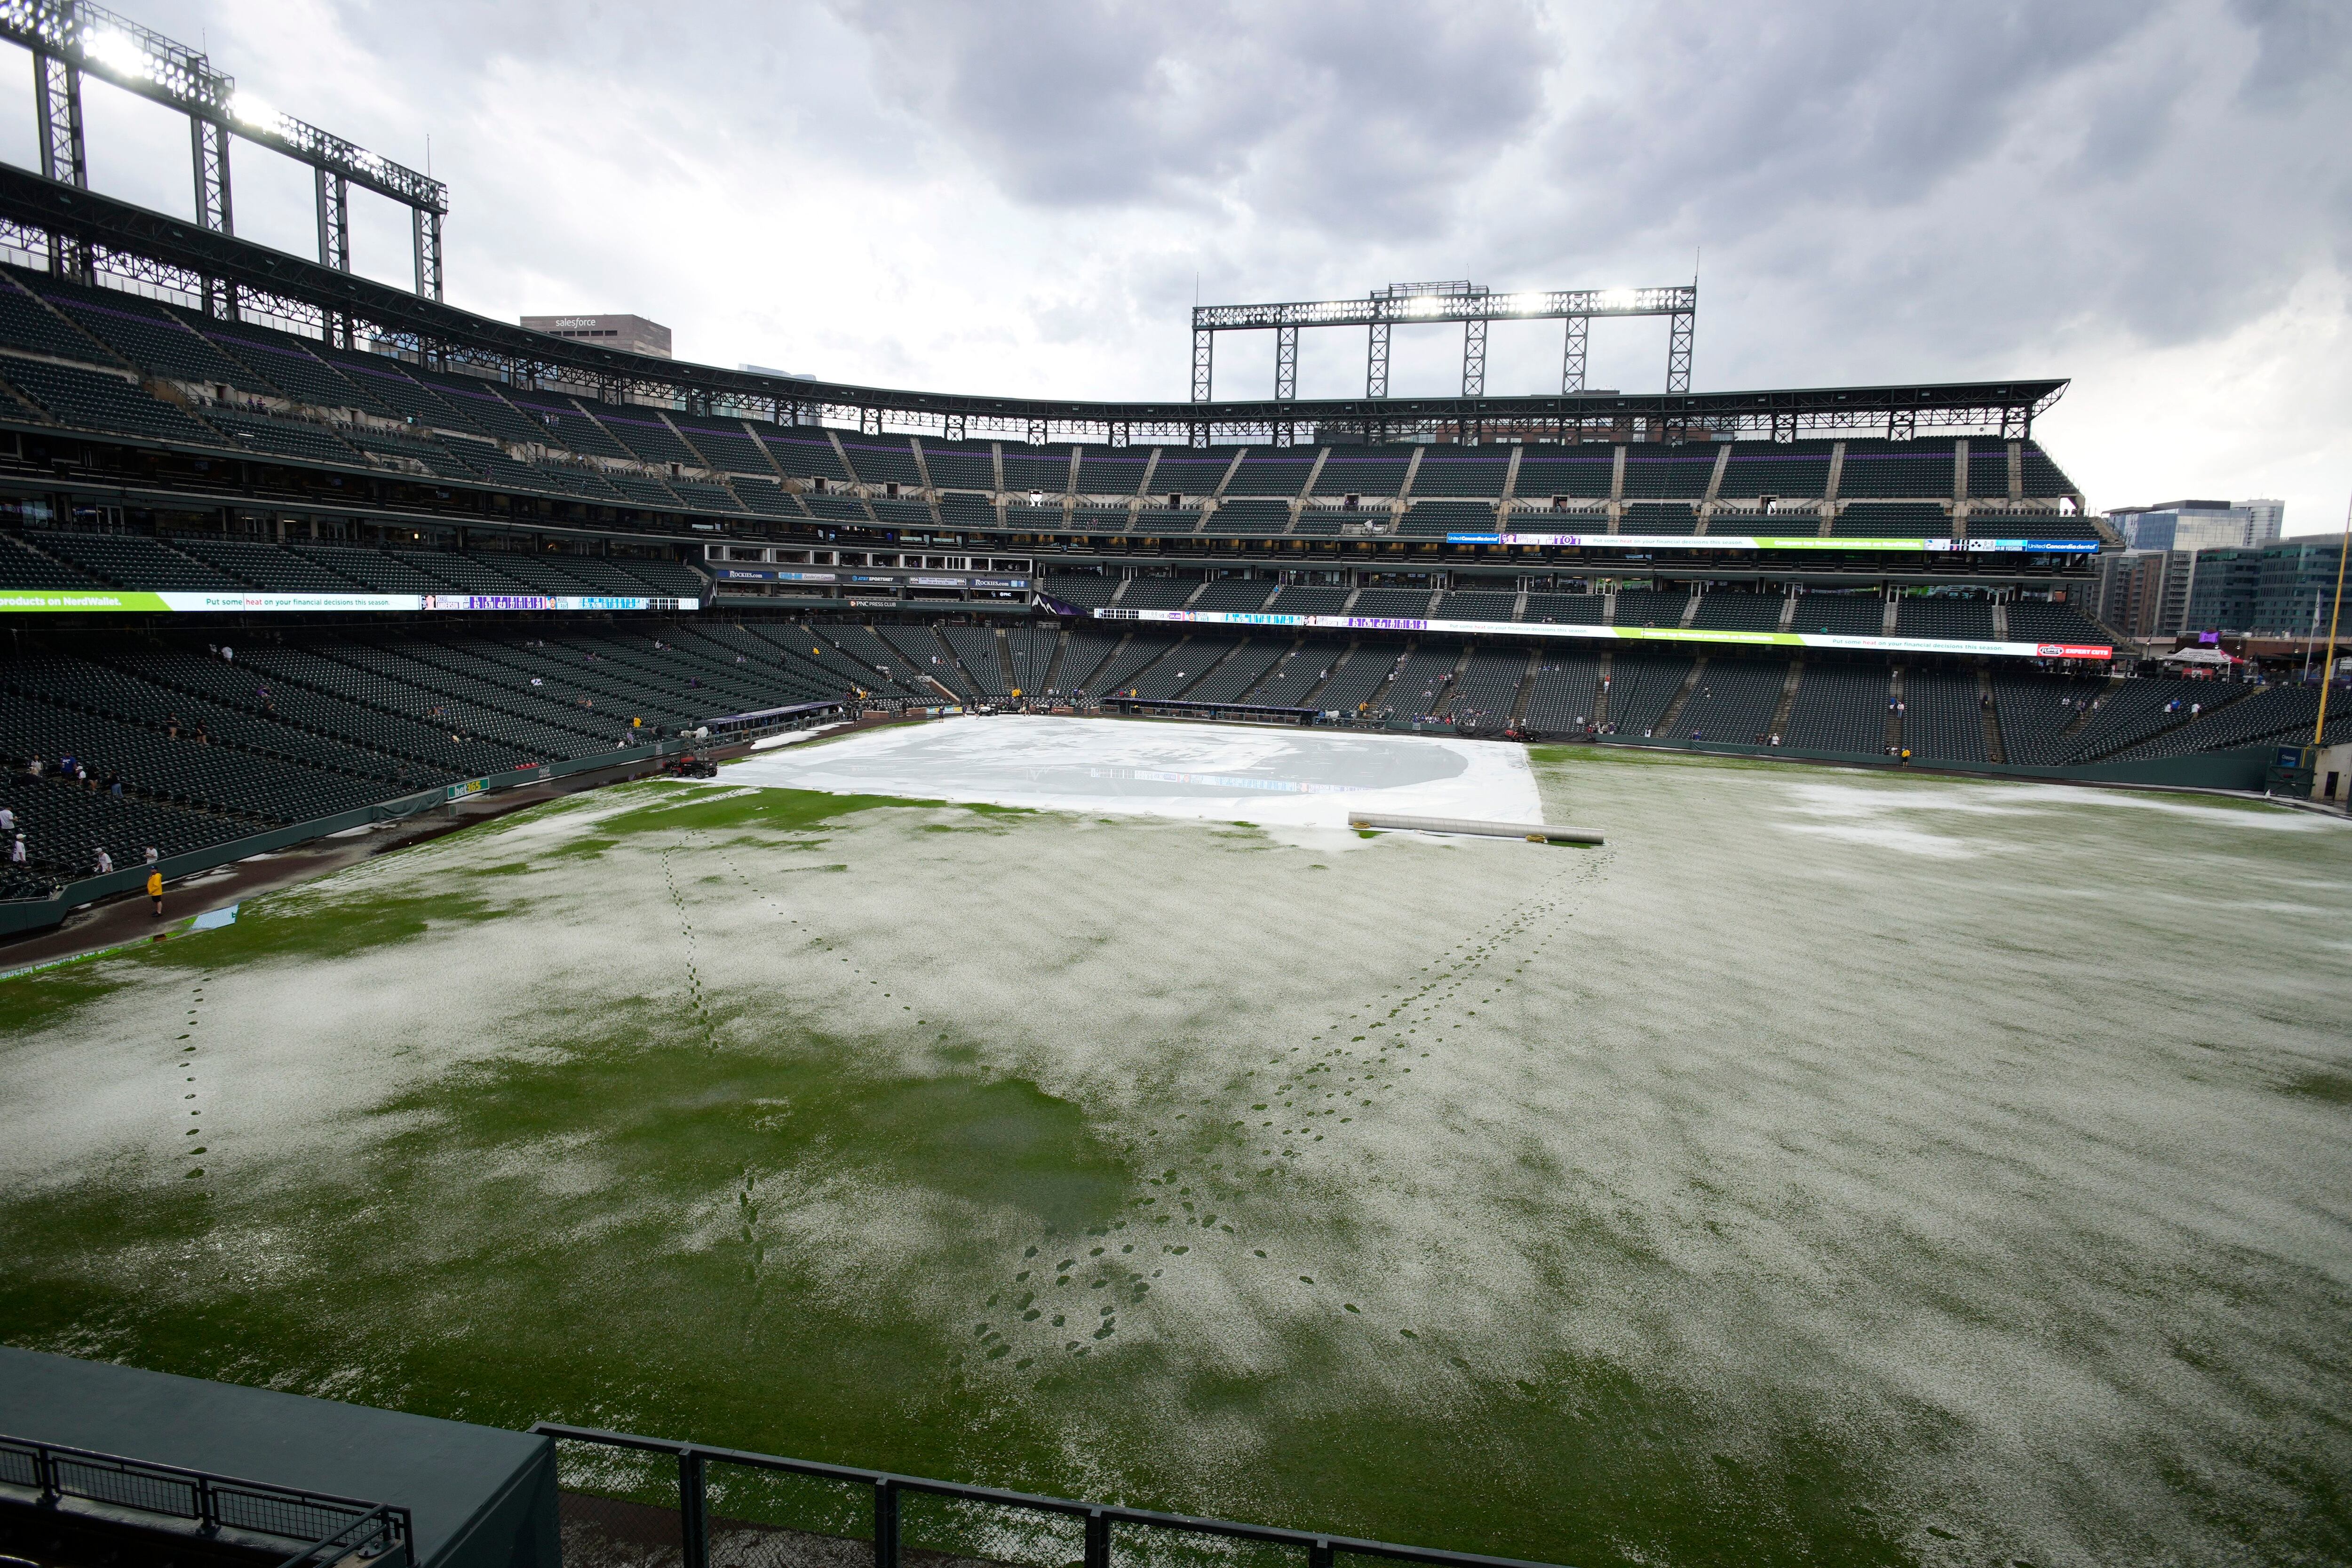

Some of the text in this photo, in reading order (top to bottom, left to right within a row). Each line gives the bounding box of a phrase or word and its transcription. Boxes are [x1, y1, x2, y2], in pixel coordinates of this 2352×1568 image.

[555, 318, 596, 329] salesforce
[48, 597, 61, 606] on
[64, 597, 122, 606] NerdWallet.
[455, 780, 481, 796] bet365
